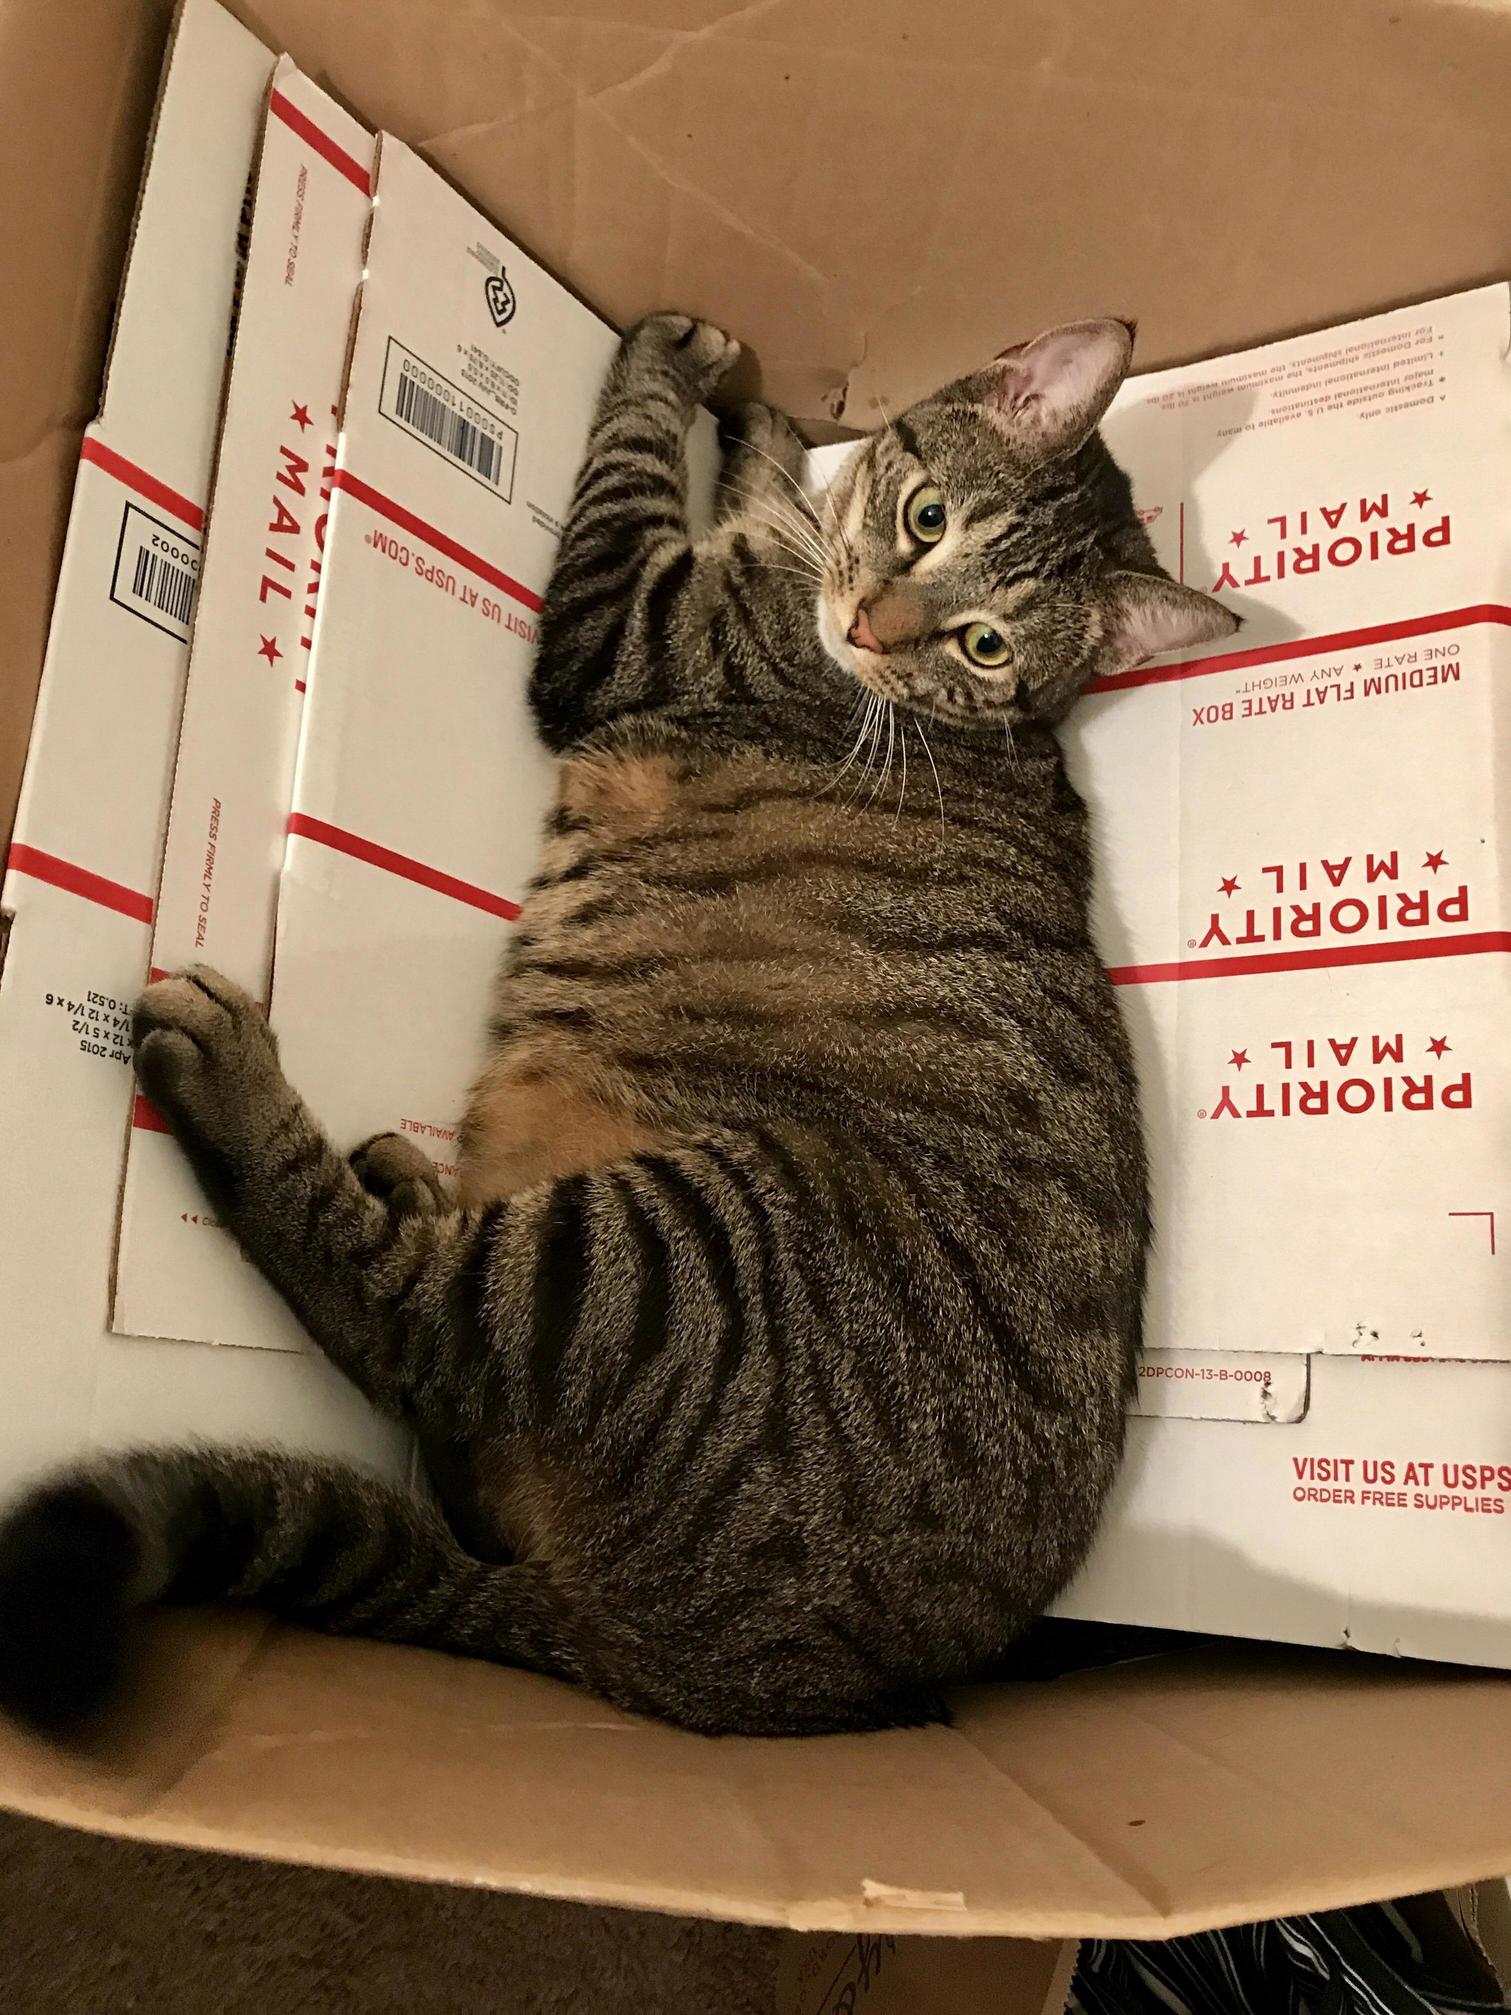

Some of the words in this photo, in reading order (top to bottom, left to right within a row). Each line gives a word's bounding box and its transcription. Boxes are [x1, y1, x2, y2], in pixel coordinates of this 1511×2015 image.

[259, 444, 309, 603] MAIL
[1267, 493, 1390, 540] MAIL
[460, 585, 479, 609] AT
[481, 598, 502, 624] US
[505, 612, 540, 645] VISIT
[1373, 652, 1418, 671] RATE
[1422, 643, 1460, 661] ONE
[1310, 664, 1345, 682] ANY
[1363, 662, 1460, 697] MEDIUM
[1241, 692, 1295, 719] RATE
[1302, 681, 1355, 708] FLAT
[1192, 702, 1234, 727] BOX
[209, 797, 221, 841] PRESS
[203, 841, 216, 892] FIRMLY
[1262, 850, 1399, 894] MAIL
[199, 894, 210, 913] TO
[194, 914, 207, 948] SEAL
[45, 993, 54, 1006] 6
[57, 996, 65, 1007] x
[67, 1000, 85, 1017] 1/4
[87, 990, 117, 1010] 0.521
[88, 1008, 100, 1022] 12
[103, 1013, 110, 1024] x
[72, 1019, 90, 1036] 1/2
[92, 1027, 101, 1039] 5
[103, 1030, 110, 1040] x
[80, 1040, 108, 1058] 2015
[112, 1033, 125, 1047] 12
[109, 1050, 131, 1065] Apr
[1271, 1034, 1404, 1070] MAIL
[1292, 1457, 1355, 1483] VISIT
[1362, 1460, 1396, 1484] US
[1402, 1462, 1435, 1487] AT
[1442, 1463, 1511, 1492] USPS
[1292, 1487, 1355, 1505] ORDER
[1361, 1490, 1408, 1508] FREE
[1413, 1493, 1505, 1514] SUPPLIES
